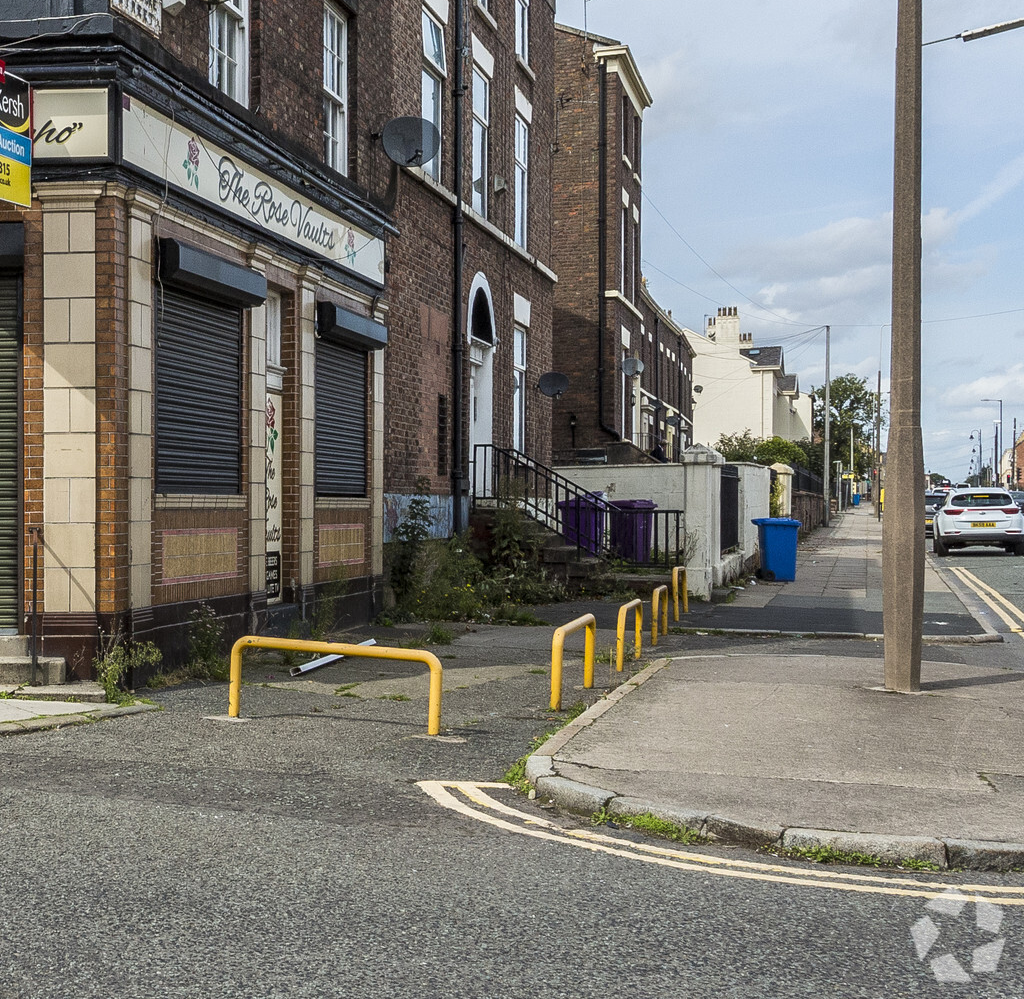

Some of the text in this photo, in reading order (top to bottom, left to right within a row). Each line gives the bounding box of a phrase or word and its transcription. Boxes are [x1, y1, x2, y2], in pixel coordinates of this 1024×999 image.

[218, 156, 335, 251] The Rose Vaults
